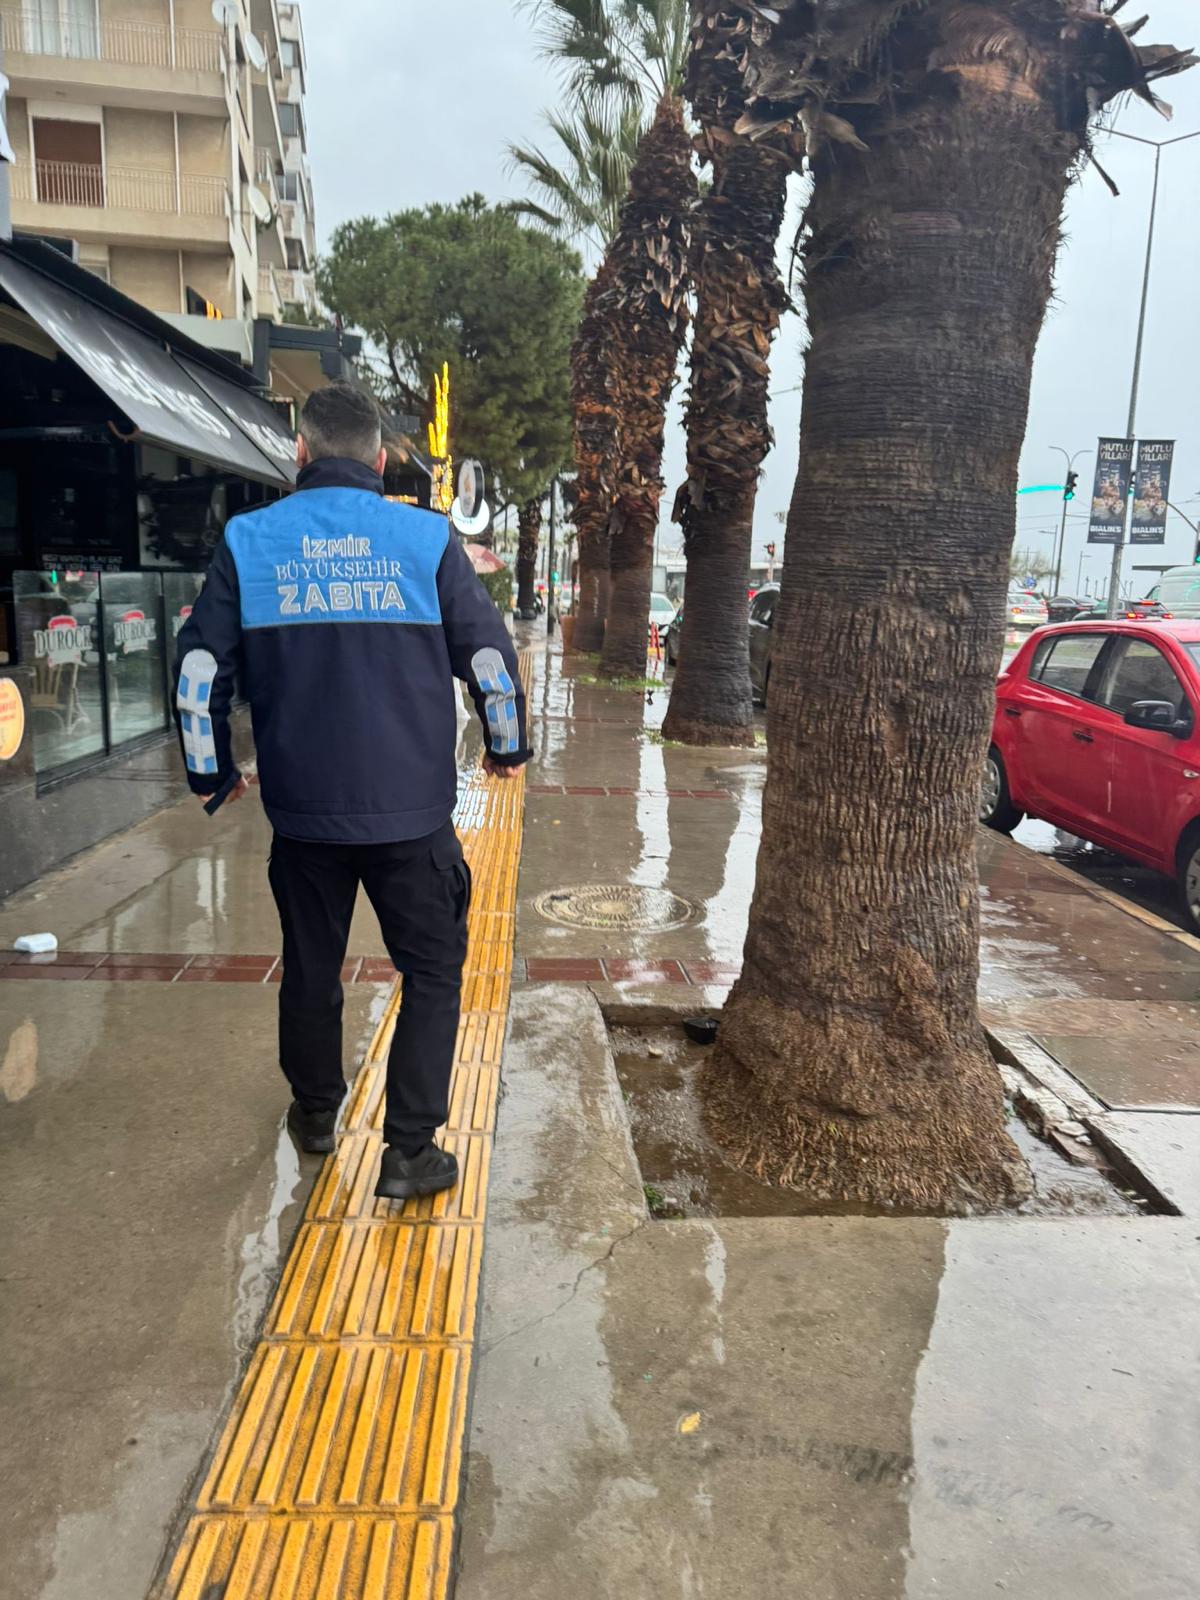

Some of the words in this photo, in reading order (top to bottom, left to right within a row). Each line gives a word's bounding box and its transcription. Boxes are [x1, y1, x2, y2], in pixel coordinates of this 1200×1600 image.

[302, 534, 371, 559] İZMİR
[275, 556, 403, 581] BÜYÜKŞEHİR
[277, 581, 406, 615] ZABITA
[34, 626, 92, 656] DUROCK
[114, 619, 156, 643] DUROCK
